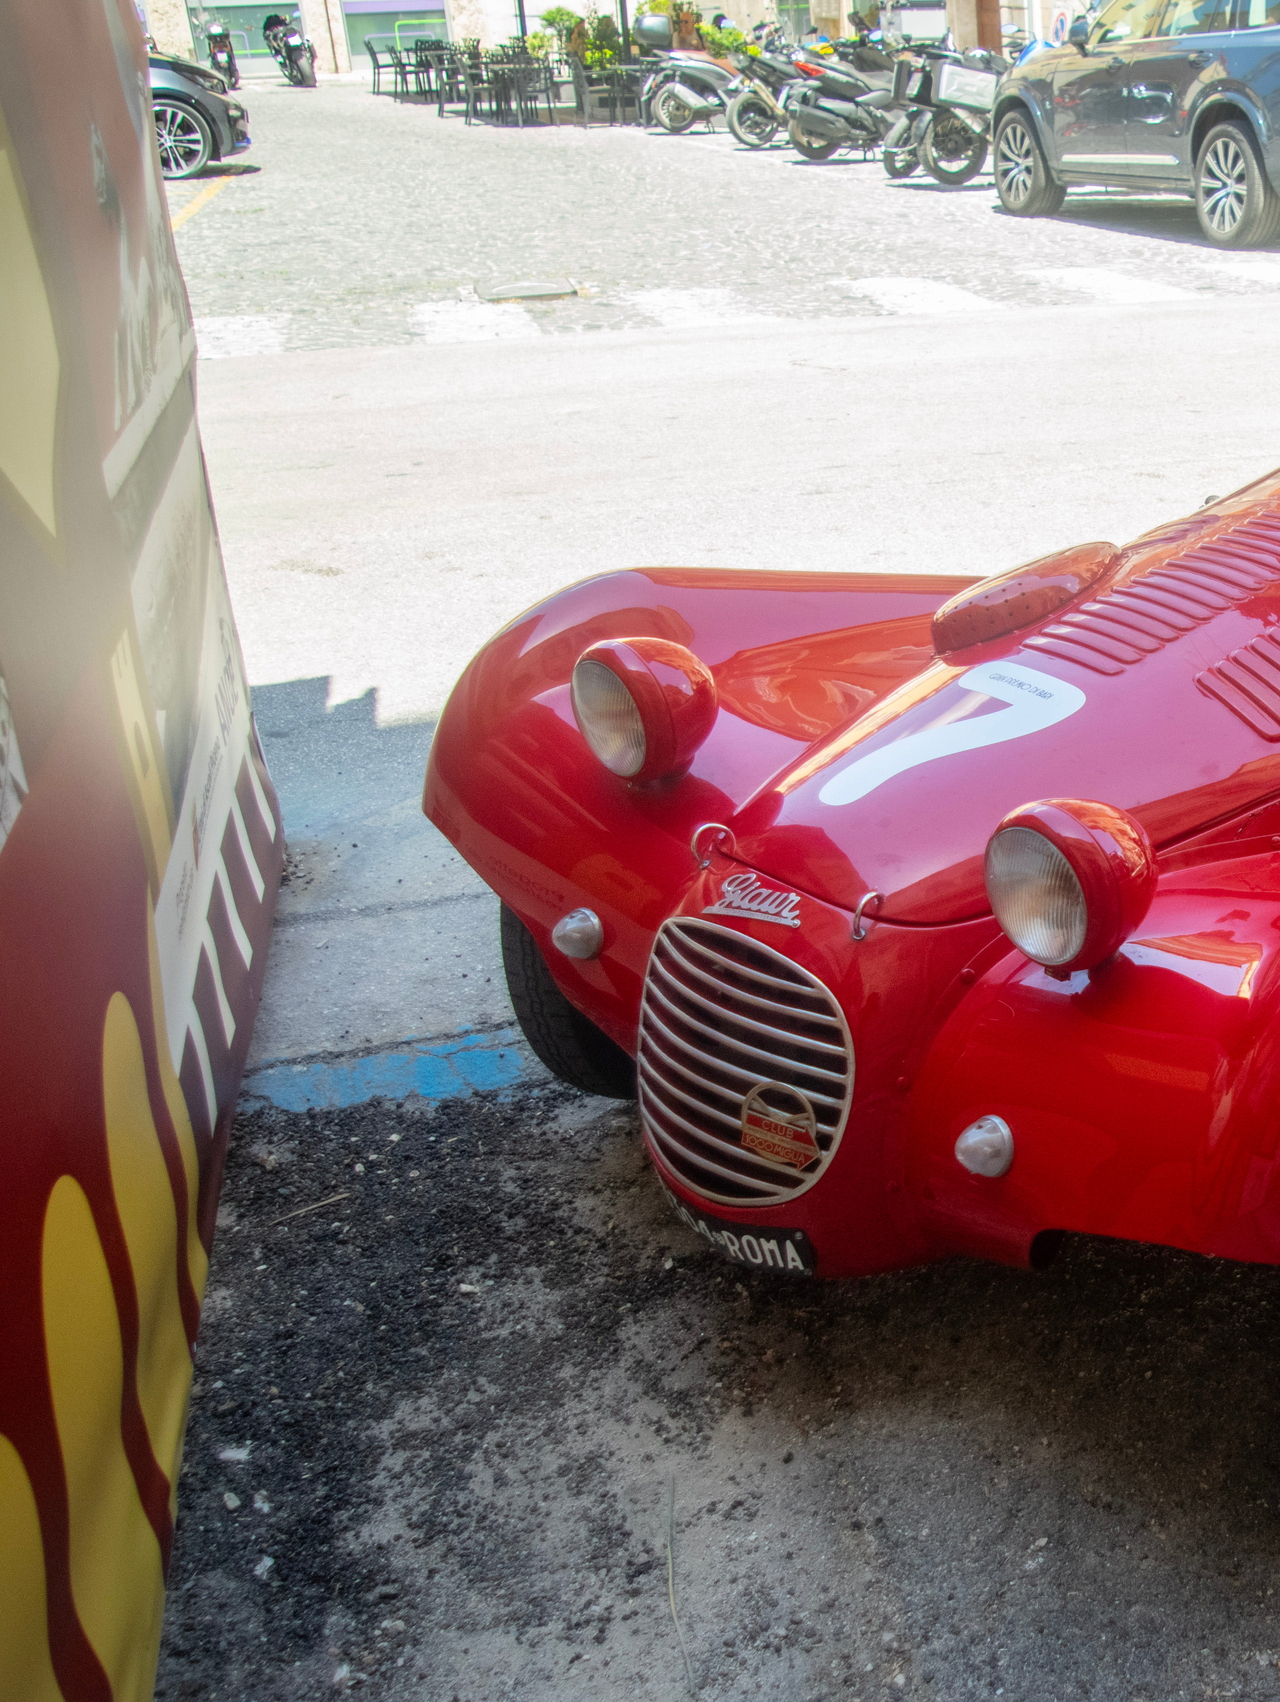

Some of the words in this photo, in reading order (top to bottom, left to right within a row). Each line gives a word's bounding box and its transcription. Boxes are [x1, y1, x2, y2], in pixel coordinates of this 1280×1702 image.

[818, 660, 1087, 806] 7
[761, 1120, 794, 1139] CLUB
[745, 1134, 774, 1152] 1000
[773, 1144, 805, 1164] MIGLIA
[721, 1230, 805, 1271] ROMA
